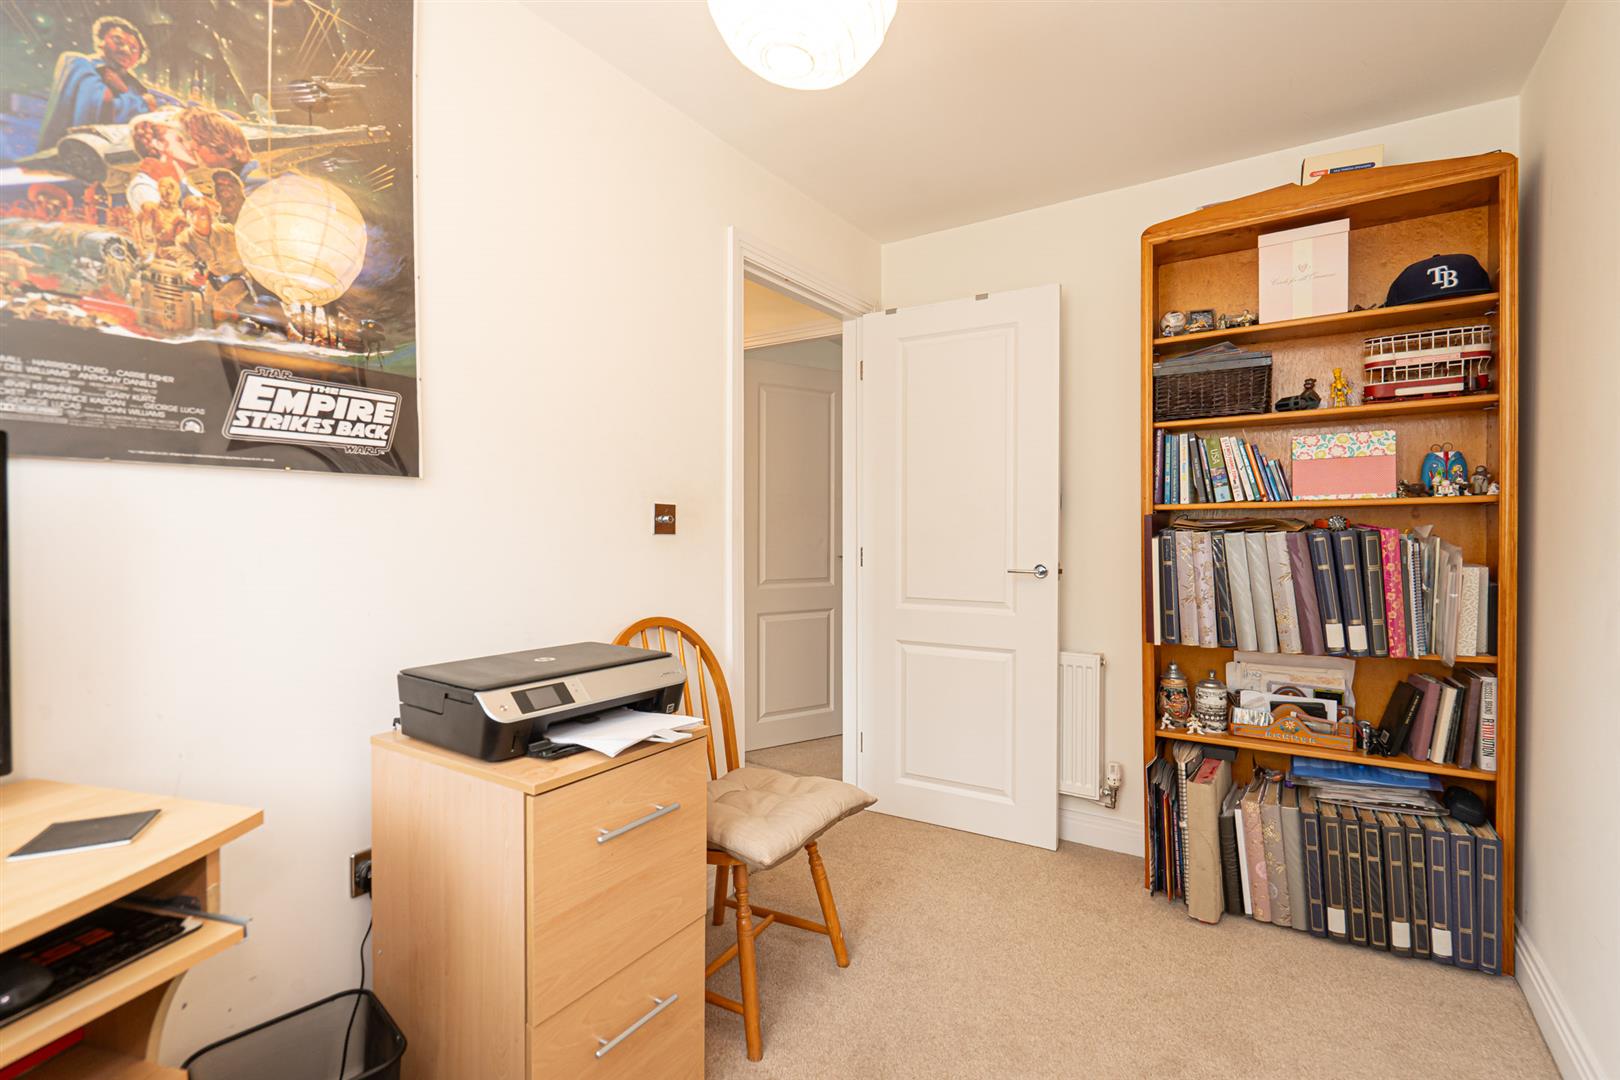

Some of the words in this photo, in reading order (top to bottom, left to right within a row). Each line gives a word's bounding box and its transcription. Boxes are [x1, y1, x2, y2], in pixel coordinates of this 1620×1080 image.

[1427, 265, 1458, 289] TB
[255, 366, 293, 379] STAR
[312, 385, 339, 395] THE
[238, 375, 396, 425] EMPIRE
[232, 410, 335, 435] STRIKES
[336, 420, 391, 440] BACK
[345, 446, 380, 456] WARS
[1211, 448, 1220, 465] USA
